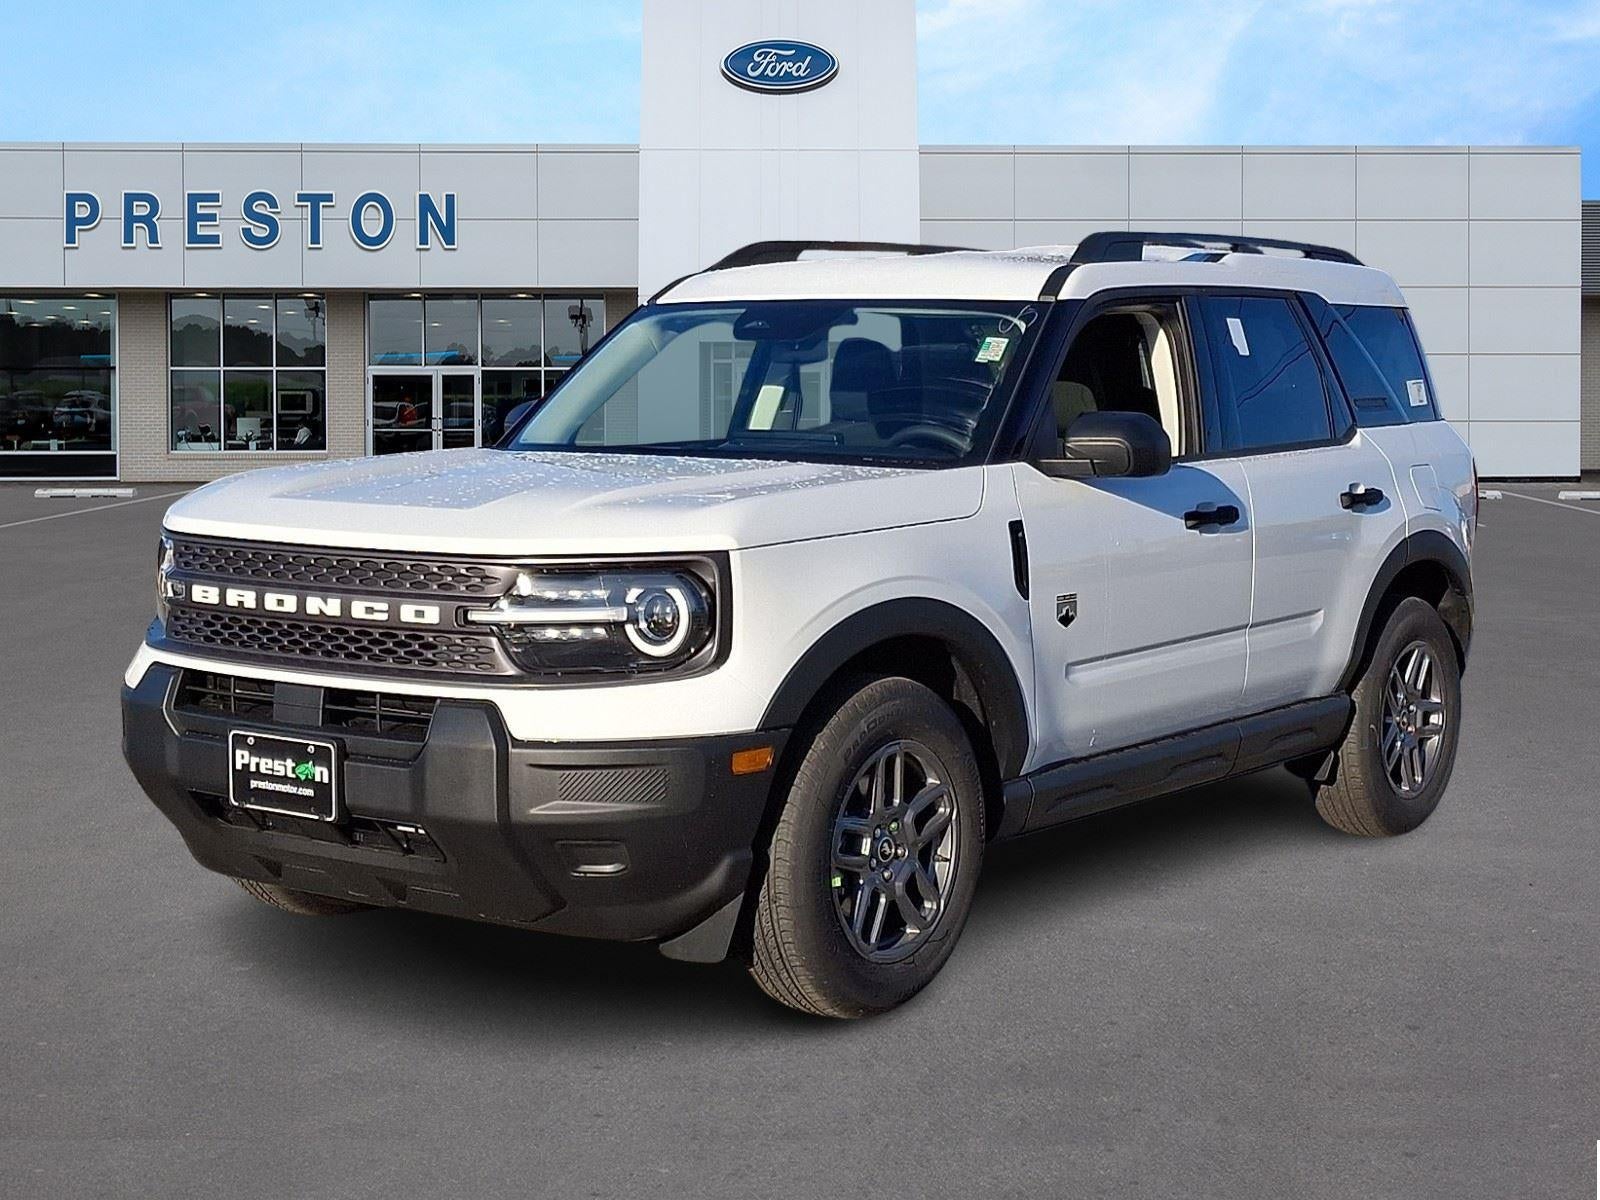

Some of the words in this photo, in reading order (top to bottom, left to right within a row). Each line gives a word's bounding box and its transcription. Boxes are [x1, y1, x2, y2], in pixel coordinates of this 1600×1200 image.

[746, 48, 813, 77] Ford
[63, 190, 458, 251] PRESTON
[191, 584, 441, 625] BRONCO
[249, 779, 315, 798] prestonmotor.com
